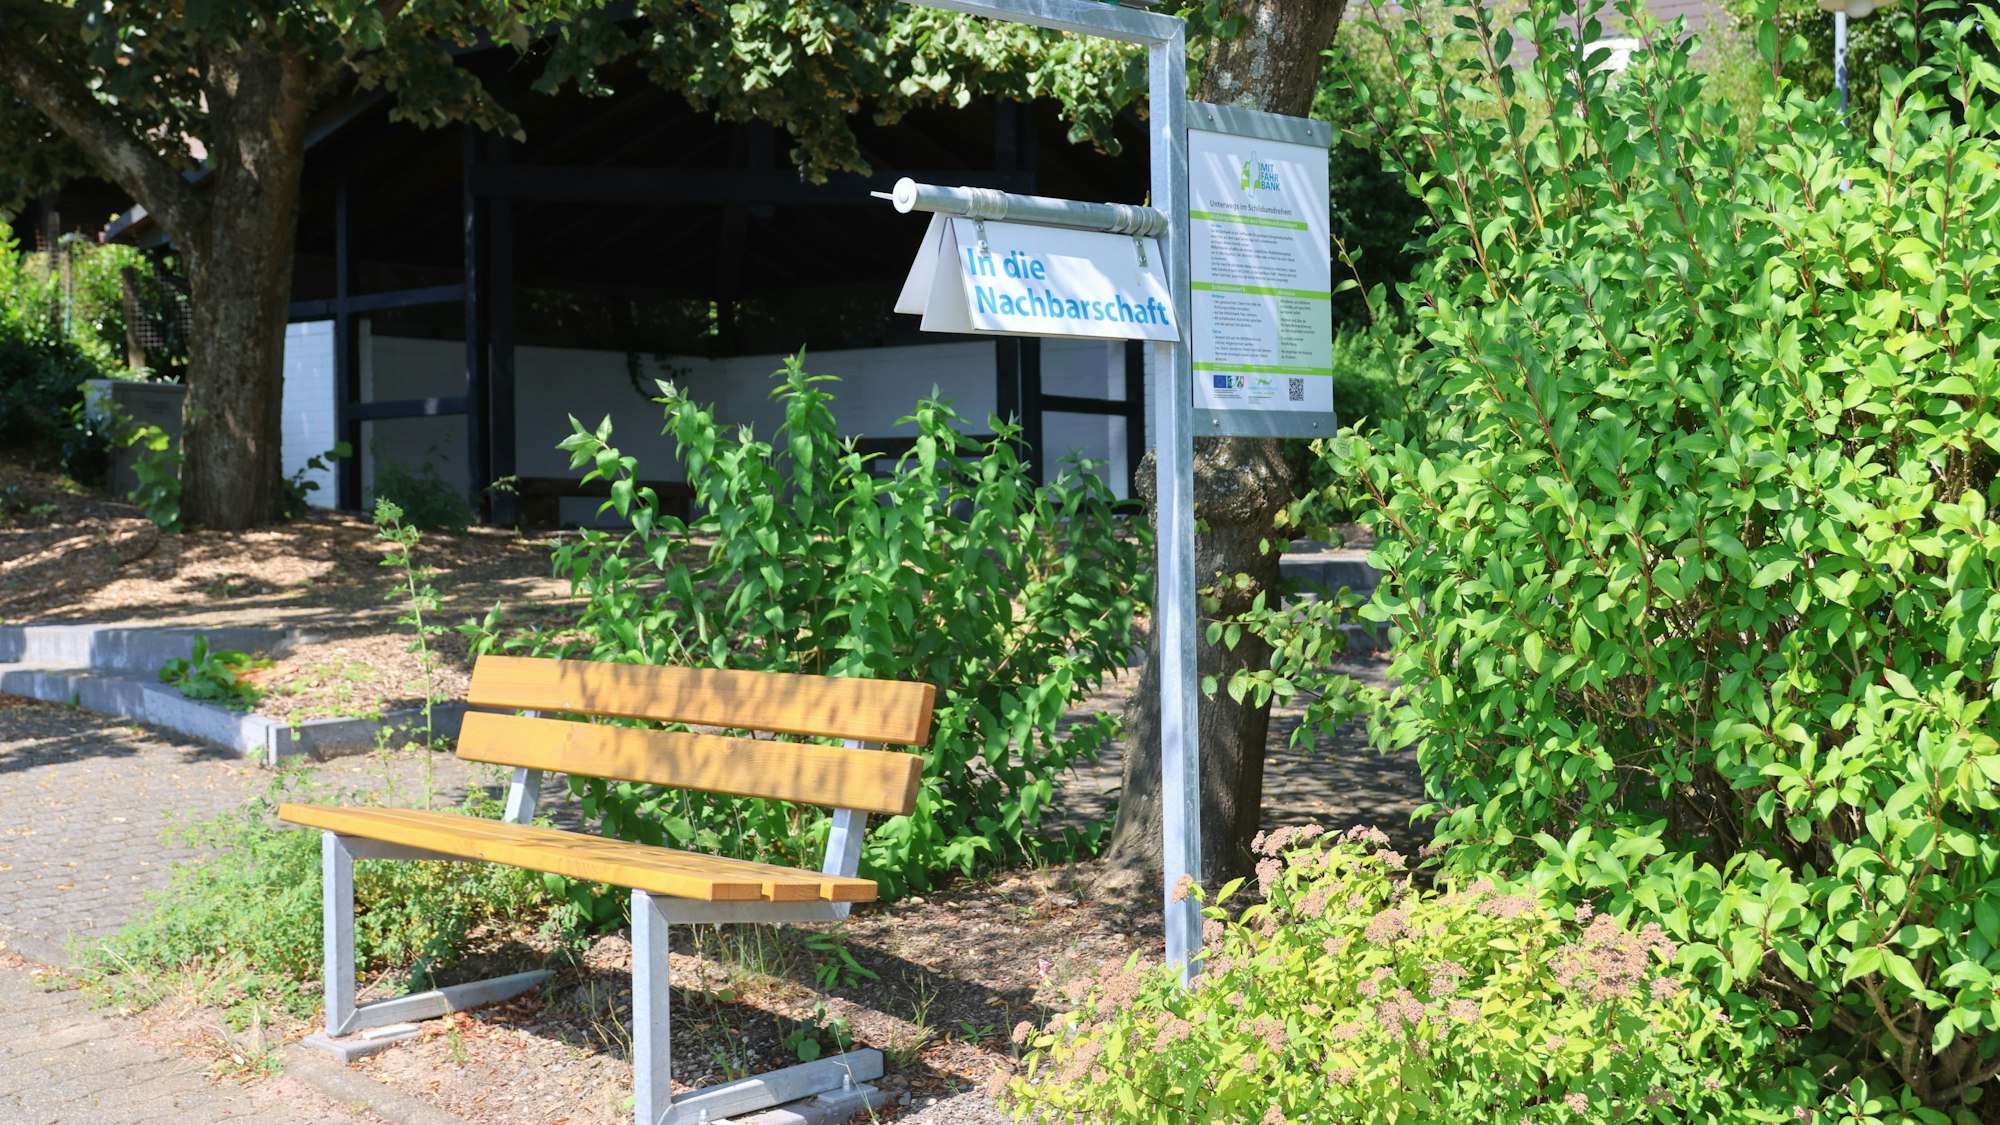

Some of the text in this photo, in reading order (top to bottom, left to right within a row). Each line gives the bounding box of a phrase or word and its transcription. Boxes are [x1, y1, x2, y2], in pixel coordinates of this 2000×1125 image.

[1261, 163, 1274, 172] MIT
[1261, 172, 1279, 182] FAHR
[1261, 181, 1280, 191] BANK
[1209, 200, 1239, 211] Unterwegs
[967, 248, 1045, 280] In die
[975, 285, 1170, 326] Nachbarschaft
